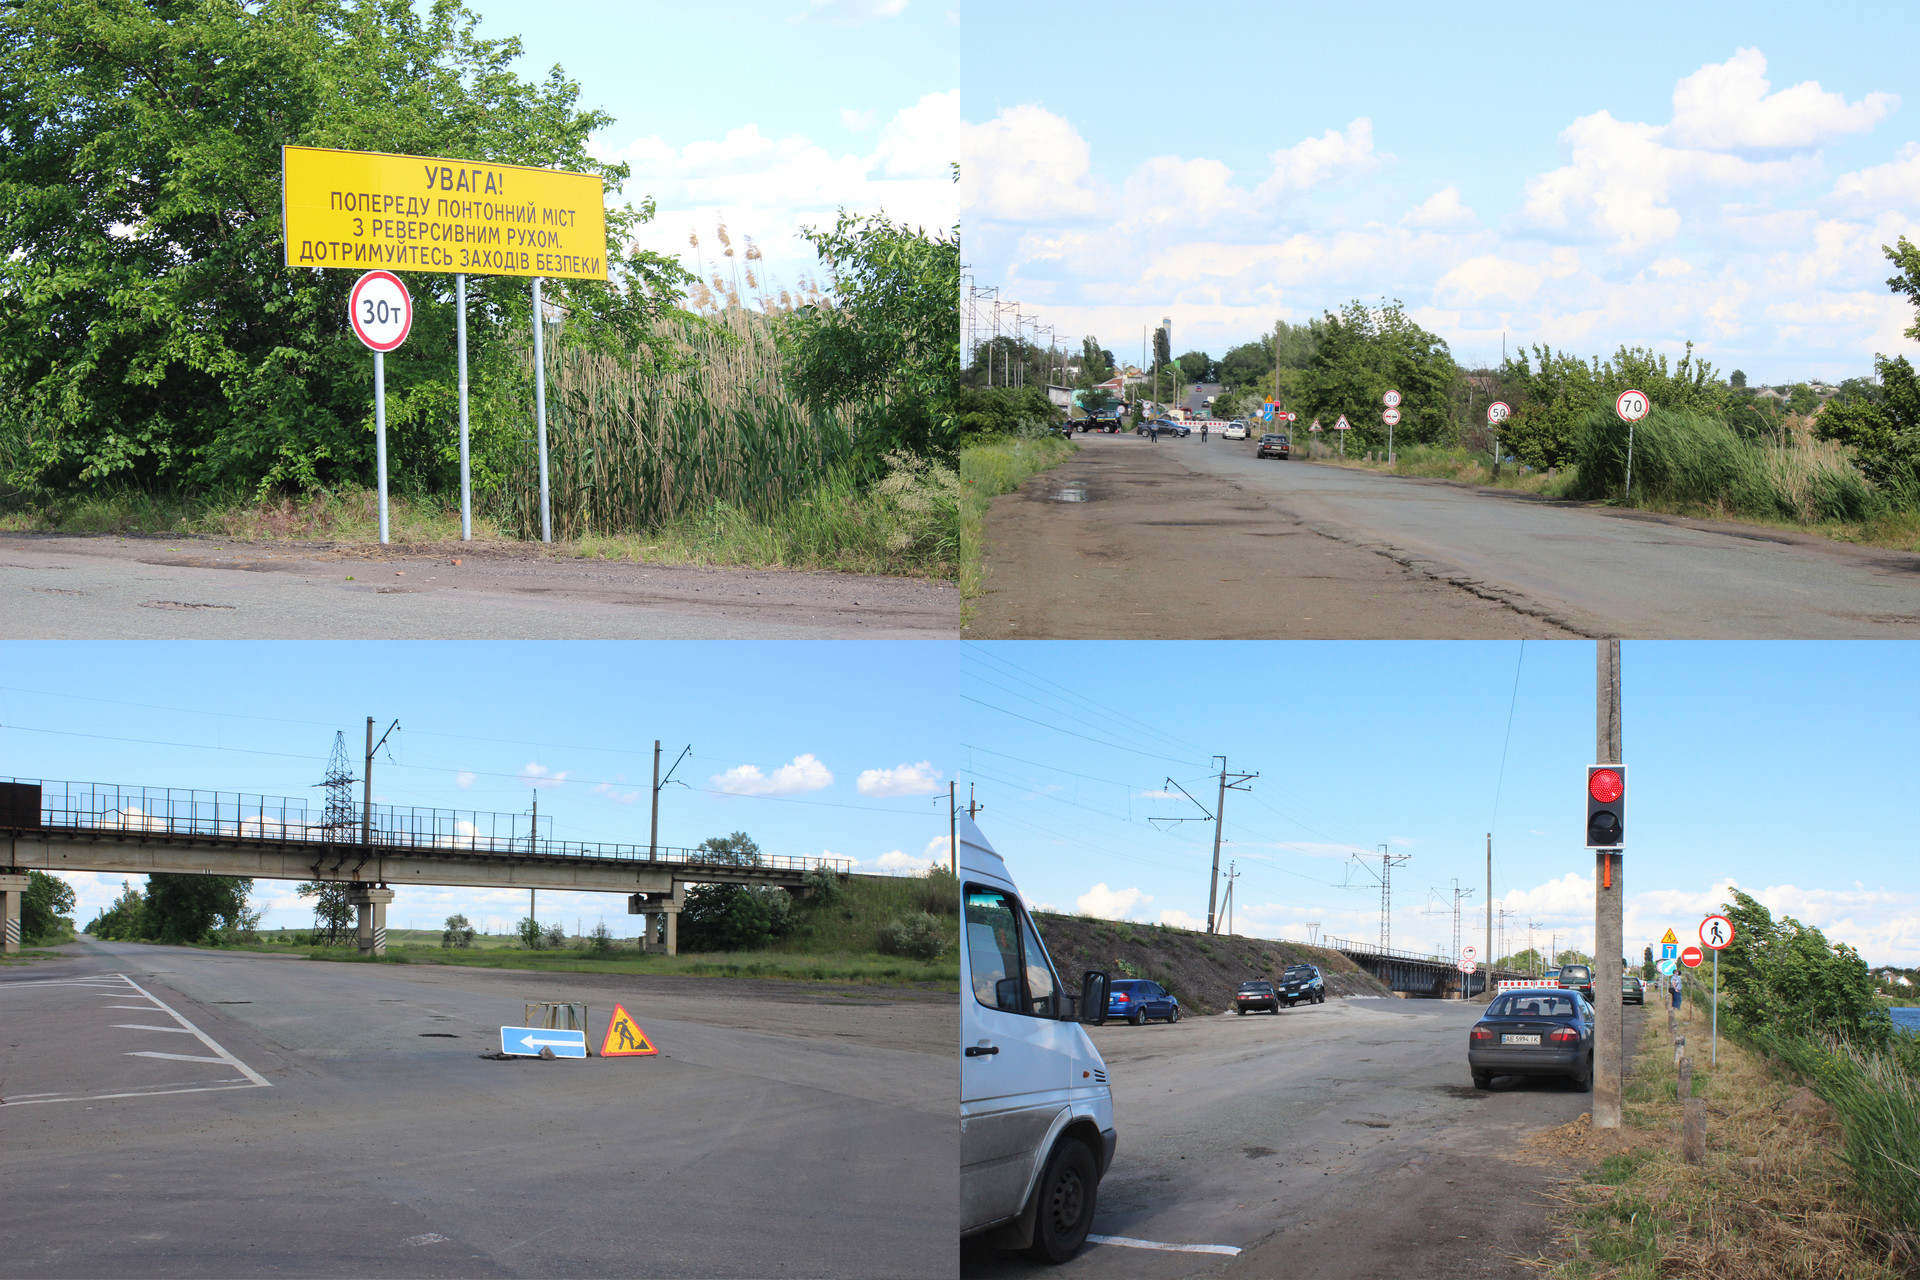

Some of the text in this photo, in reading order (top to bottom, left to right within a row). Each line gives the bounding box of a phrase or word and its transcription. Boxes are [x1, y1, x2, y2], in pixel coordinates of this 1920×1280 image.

[424, 166, 503, 195] УВАГА!
[331, 191, 576, 227] ПОПЕРЕДУ ПОНТОННИЙ МІСТ
[353, 217, 563, 249] З РЕВЕРСИВНИМ РУХОМ.
[300, 240, 600, 275] ДОТРИМУЙТЕСЬ ЗАХОДІВ БЕЗПЕКИ
[1387, 395, 1398, 403] 30
[1493, 408, 1506, 418] 50
[1624, 400, 1642, 412] 70
